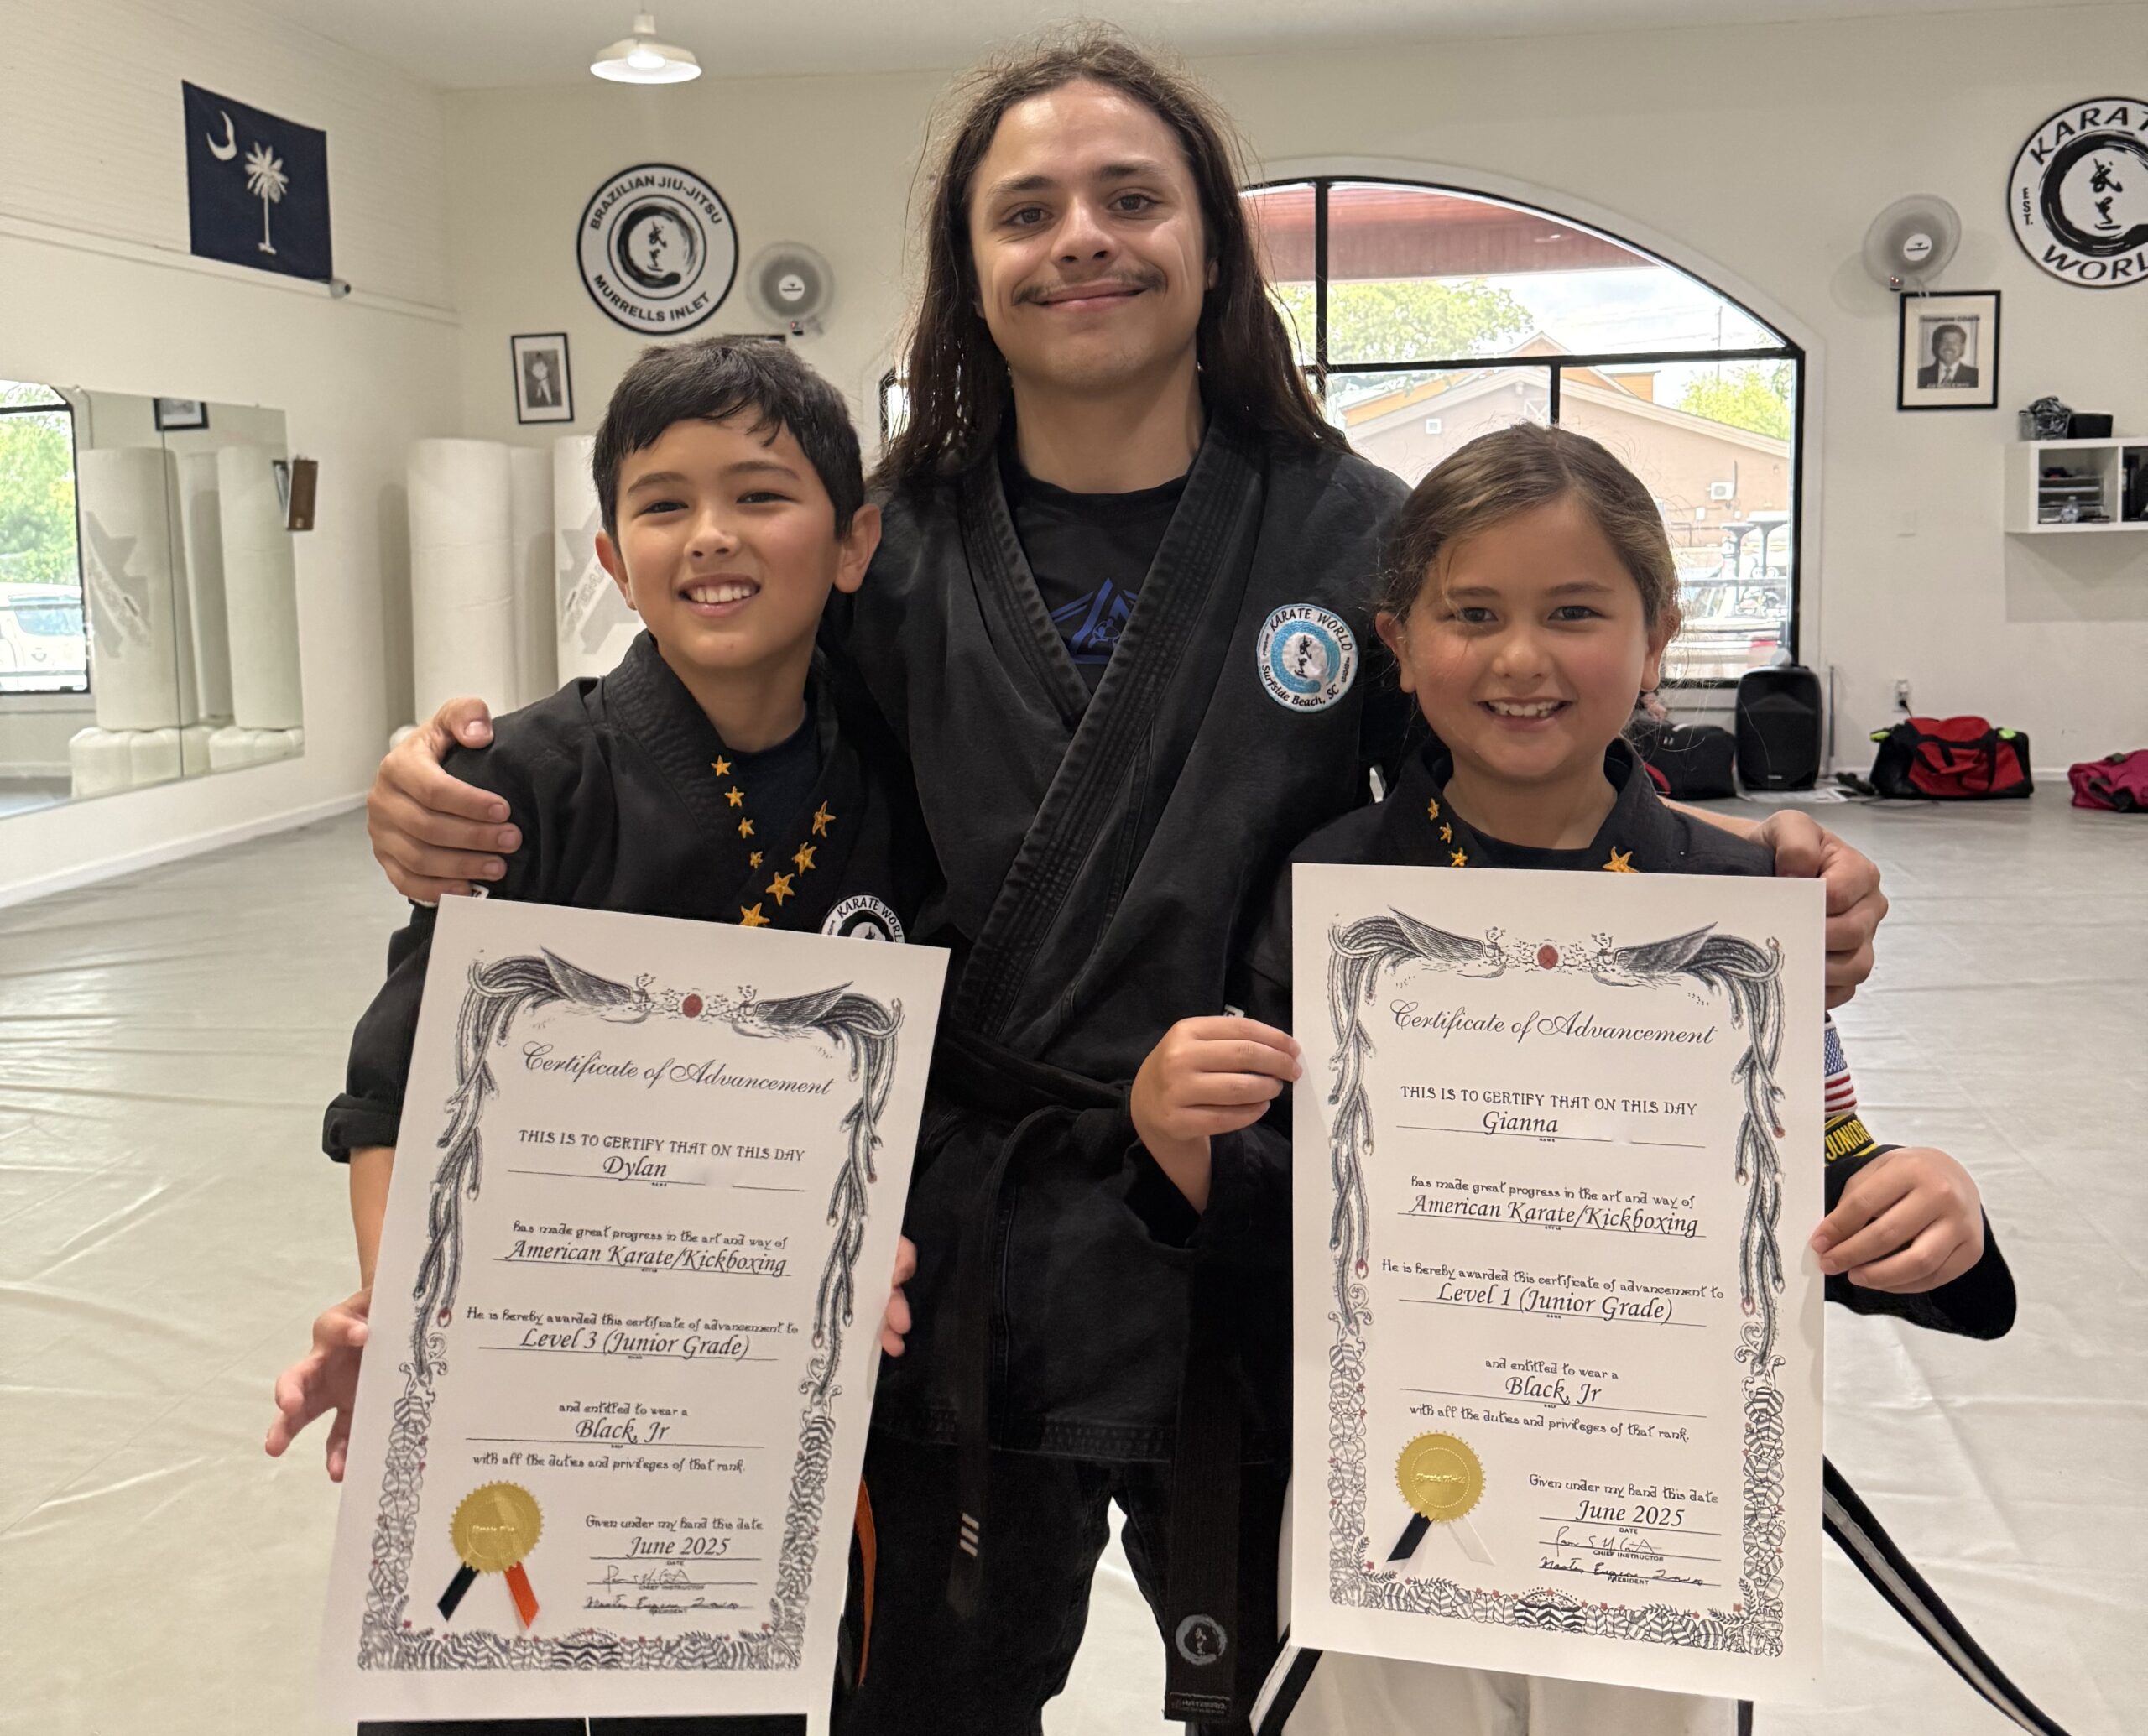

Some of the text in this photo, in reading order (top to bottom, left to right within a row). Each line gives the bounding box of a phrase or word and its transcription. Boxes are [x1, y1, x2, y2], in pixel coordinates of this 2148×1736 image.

[590, 175, 722, 230] BRAZILIAN JIU-JITSU
[2022, 187, 2033, 226] EST.
[593, 274, 711, 321] MURRELLS INLET
[1270, 607, 1353, 651] KARATE WORLD
[1262, 665, 1340, 706] Surfside Beach, SC
[837, 897, 879, 918] KARATE
[1389, 999, 1718, 1044] Certificate of Advancement
[523, 1040, 837, 1095] Certificate of Advancement
[1400, 1086, 1697, 1115] THIS IS TO CERTIFY THAT ON THIS DAY
[1483, 1111, 1558, 1135] Gianna
[519, 1129, 805, 1162] THIS IS TO CERTIFY THAT ON THIS DAY
[1825, 1119, 1871, 1160] JUNIOR
[602, 1155, 667, 1181] Dylan
[1411, 1175, 1695, 1209] has made great progress in the art and way of
[1408, 1195, 1698, 1238] American Karate/Kickboxing
[513, 1220, 788, 1250] has made great progress in the art and way of
[504, 1239, 787, 1277] American Karate/Kickboxing
[1382, 1259, 1724, 1299] He is hereby awarded this certificate of advancement to
[1436, 1282, 1672, 1326] Level 1 (Junior Grade)
[467, 1306, 799, 1334] He is hereby awarded this certificate of advancement to
[519, 1327, 749, 1361] Level 3 (Junior Grade)
[1485, 1357, 1506, 1369] and
[1510, 1358, 1557, 1374] entitled
[1561, 1362, 1575, 1375] to
[1579, 1368, 1608, 1379] wear
[559, 1400, 581, 1412] and
[584, 1401, 630, 1415] entitled
[634, 1403, 647, 1415] to
[651, 1407, 678, 1416] wear
[1576, 1383, 1602, 1405] Jr
[644, 1421, 670, 1442] Jr
[1410, 1403, 1434, 1416] with
[1460, 1406, 1479, 1421] the
[1483, 1410, 1520, 1424] duties
[1523, 1415, 1544, 1426] and
[1548, 1417, 1606, 1435] privileges
[1610, 1422, 1623, 1436] of
[1628, 1422, 1655, 1437] that
[1658, 1427, 1689, 1443] rank.
[473, 1452, 498, 1465] with
[526, 1452, 545, 1466] the
[548, 1453, 584, 1468] duties
[588, 1455, 609, 1468] and
[613, 1457, 669, 1472] privileges
[672, 1457, 686, 1472] of
[689, 1457, 715, 1471] that
[1530, 1473, 1718, 1504] Given under my hand this date
[586, 1514, 764, 1532] Given under my hand this date
[1576, 1500, 1685, 1526] June 2025
[625, 1536, 731, 1558] June 2025
[1617, 1551, 1664, 1562] INSTRUCTOR
[1608, 1576, 1650, 1585] PRESIDENT
